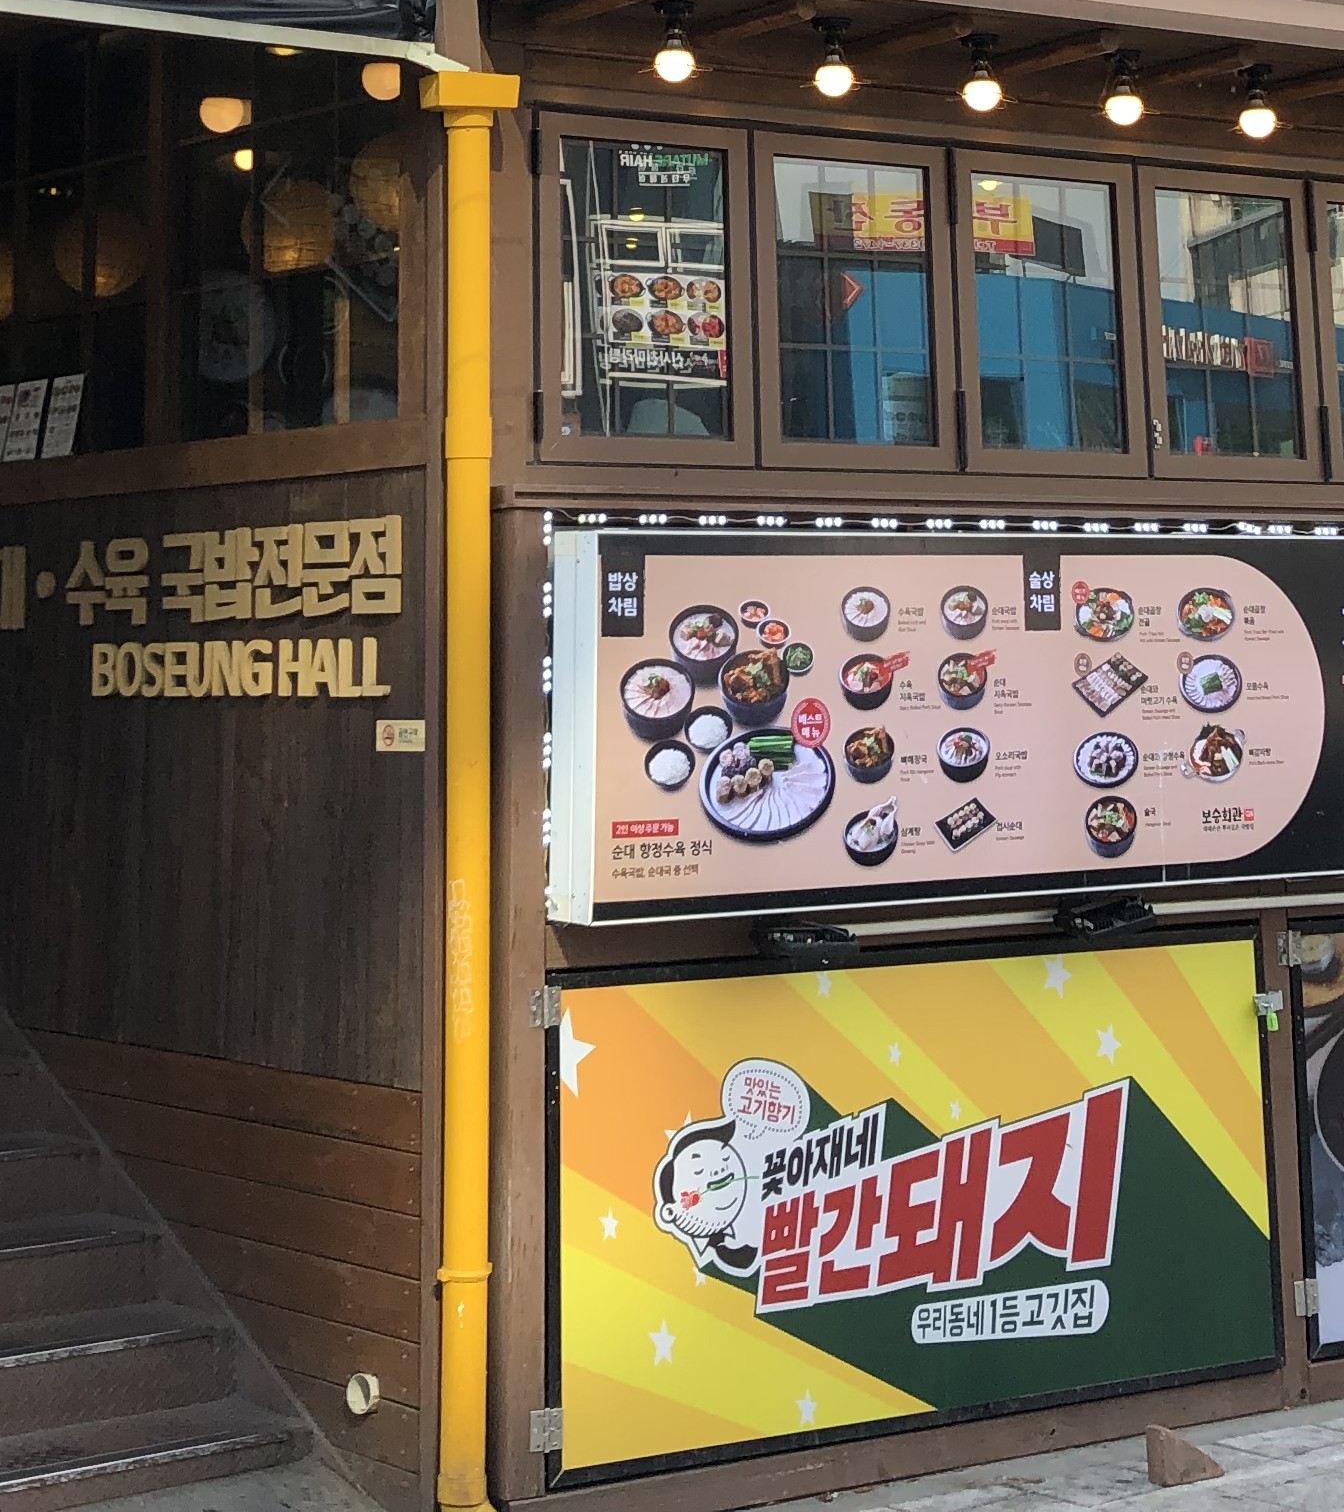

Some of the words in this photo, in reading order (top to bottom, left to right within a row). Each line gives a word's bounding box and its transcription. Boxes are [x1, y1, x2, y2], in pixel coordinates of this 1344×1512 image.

[64, 537, 151, 626] 수육
[161, 514, 403, 623] 국밥전문점
[607, 571, 639, 592] 밥상
[1028, 570, 1055, 590] 술상
[607, 596, 638, 617] 차림
[1029, 594, 1055, 613] 차림
[91, 637, 274, 698] BOSEUNG
[277, 636, 392, 698] HALL
[1202, 806, 1243, 824] 보승회관
[611, 843, 635, 860] 순대
[690, 840, 713, 856] 정식
[743, 1076, 780, 1102] 맛있는
[737, 1097, 796, 1125] 고기향기
[762, 1113, 883, 1199] 꽃아재네
[761, 1086, 1125, 1307] 빨간돼지
